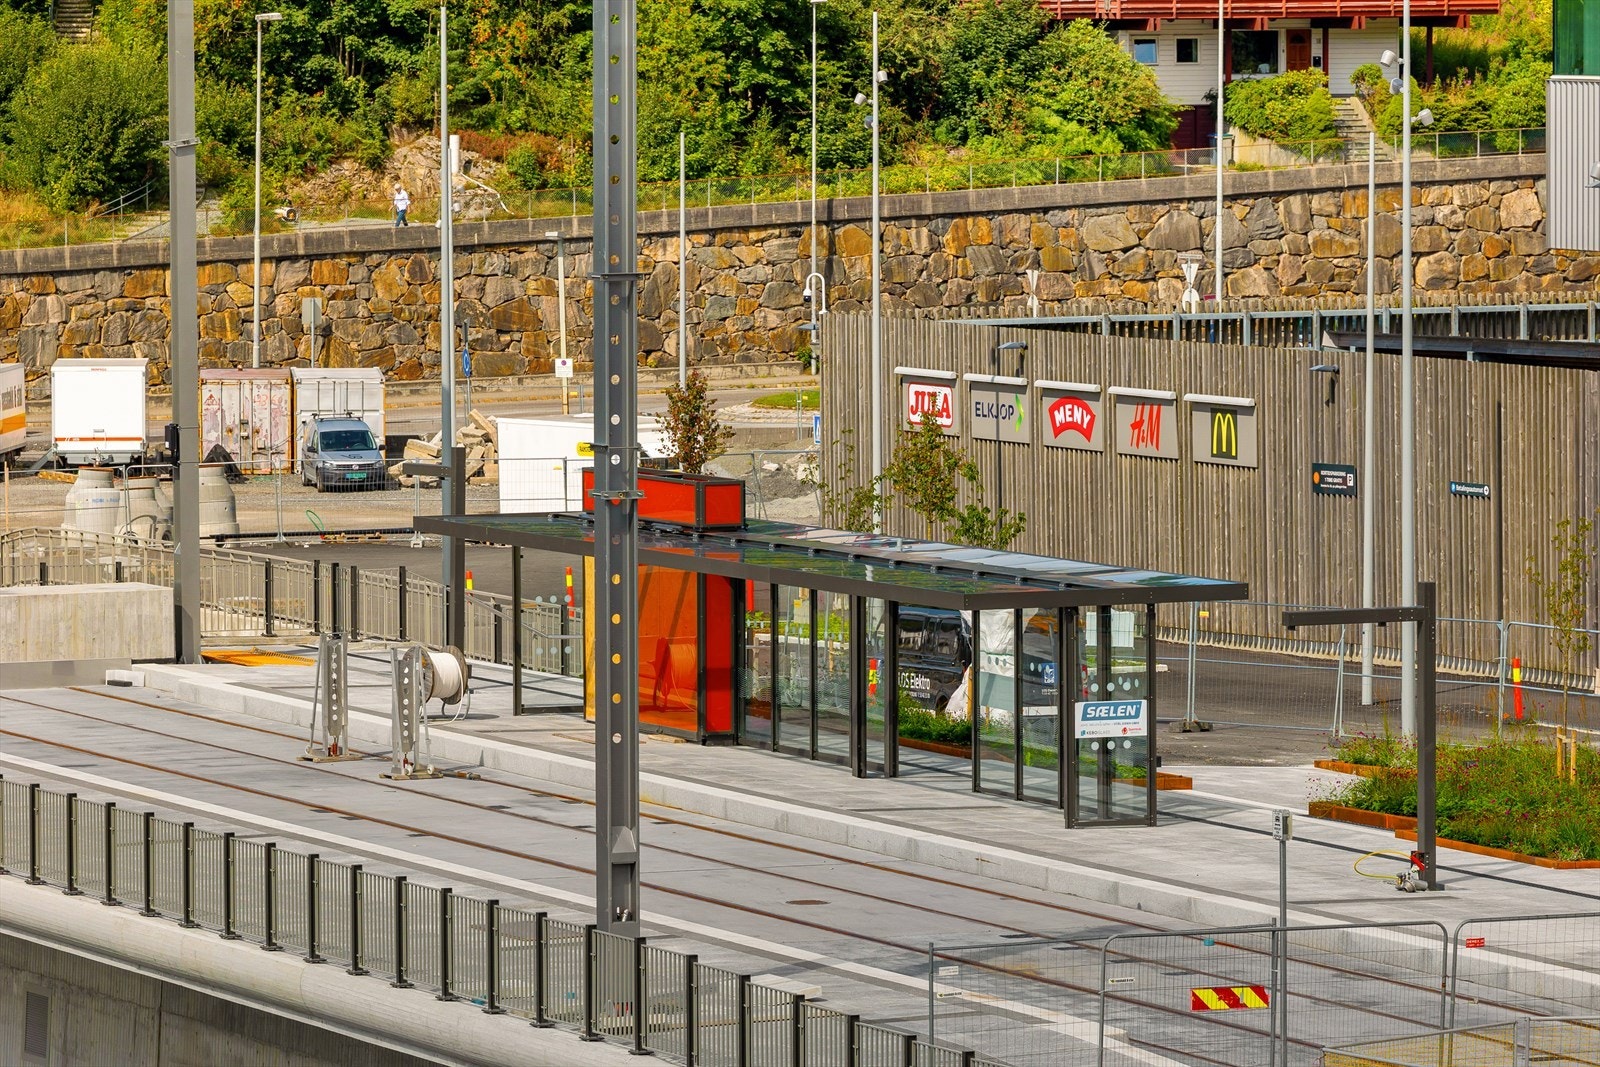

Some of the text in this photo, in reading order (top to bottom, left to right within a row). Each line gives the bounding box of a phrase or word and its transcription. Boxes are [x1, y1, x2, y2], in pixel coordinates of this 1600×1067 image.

[1054, 404, 1092, 430] MENY
[1129, 401, 1162, 452] H&M
[910, 672, 931, 690] Elektro
[1086, 704, 1136, 718] SÆLEN
